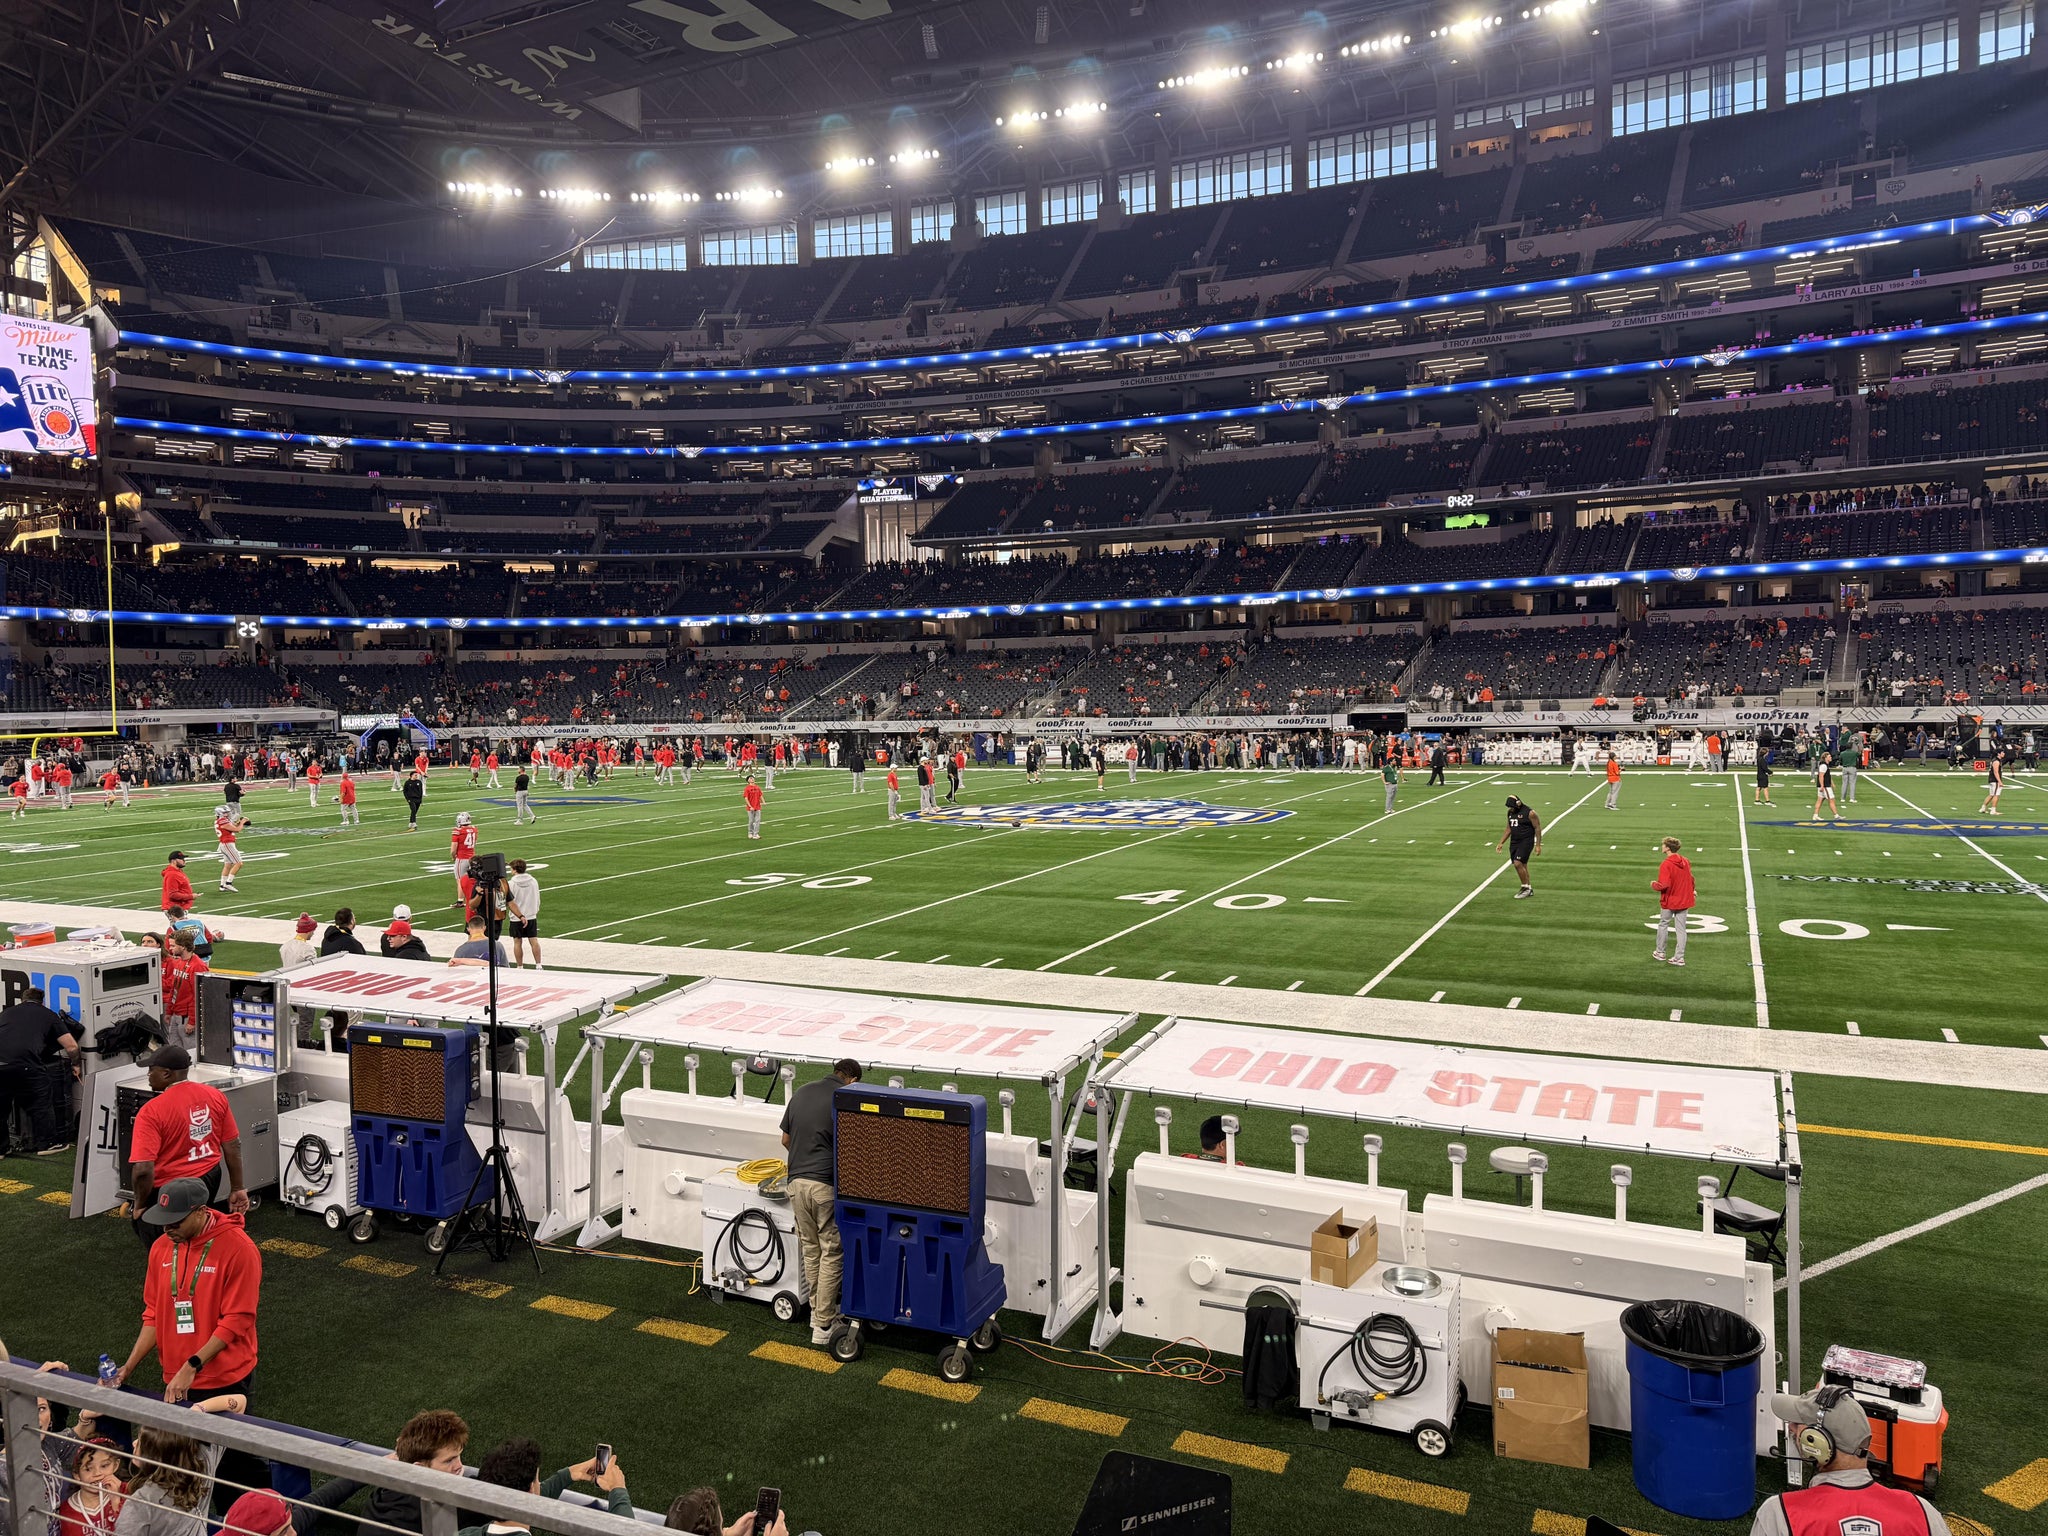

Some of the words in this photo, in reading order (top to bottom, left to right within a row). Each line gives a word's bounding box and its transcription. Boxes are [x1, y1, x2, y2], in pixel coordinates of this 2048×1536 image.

[371, 14, 583, 121] WINSTAR
[2013, 263, 2027, 272] 94
[1798, 294, 1811, 303] 73
[1814, 289, 1848, 300] LARRY
[1850, 283, 1884, 294] ALLEN
[14, 320, 37, 330] TASTES
[1611, 320, 1622, 328] 22
[1623, 315, 1659, 326] EMMITT
[1661, 310, 1689, 321] SMITH
[5, 326, 77, 348] Miller
[1449, 339, 1470, 348] TROY
[1471, 335, 1502, 345] AIKMAN
[36, 344, 78, 363] TIME,
[18, 353, 68, 371] TEXAS
[1288, 357, 1322, 367] MICHAEL
[1323, 355, 1343, 363] IRVIN
[1130, 375, 1163, 385] CHARLES
[1164, 373, 1187, 382] HALEY
[27, 383, 68, 405] Lite
[974, 392, 1003, 400] DARREN
[1004, 389, 1040, 397] WOODSON
[855, 401, 886, 409] JOHNSON
[873, 488, 903, 496] PLAYOFF
[238, 621, 259, 637] 25
[124, 716, 161, 724] GOODYEAR
[1277, 716, 1327, 725] GOODYEAR
[1427, 713, 1483, 723] GOODYEAR
[1646, 710, 1699, 720] ODYEAR
[1735, 709, 1809, 721] GOODYEAR
[759, 723, 796, 731] GOODYEAR
[1036, 718, 1085, 728] GOODYEAR
[1107, 718, 1153, 727] GOODYEAR
[1975, 761, 1985, 770] 20
[1509, 818, 1519, 827] 73
[463, 832, 476, 849] 41
[290, 970, 433, 996] OHIO
[407, 979, 592, 1011] STATE
[676, 1001, 846, 1037] OHIO
[838, 1015, 1055, 1058] STATE
[1189, 1045, 1399, 1095] OHIO
[1424, 1069, 1704, 1132] STATE
[1140, 1496, 1216, 1525] SENNHEISER
